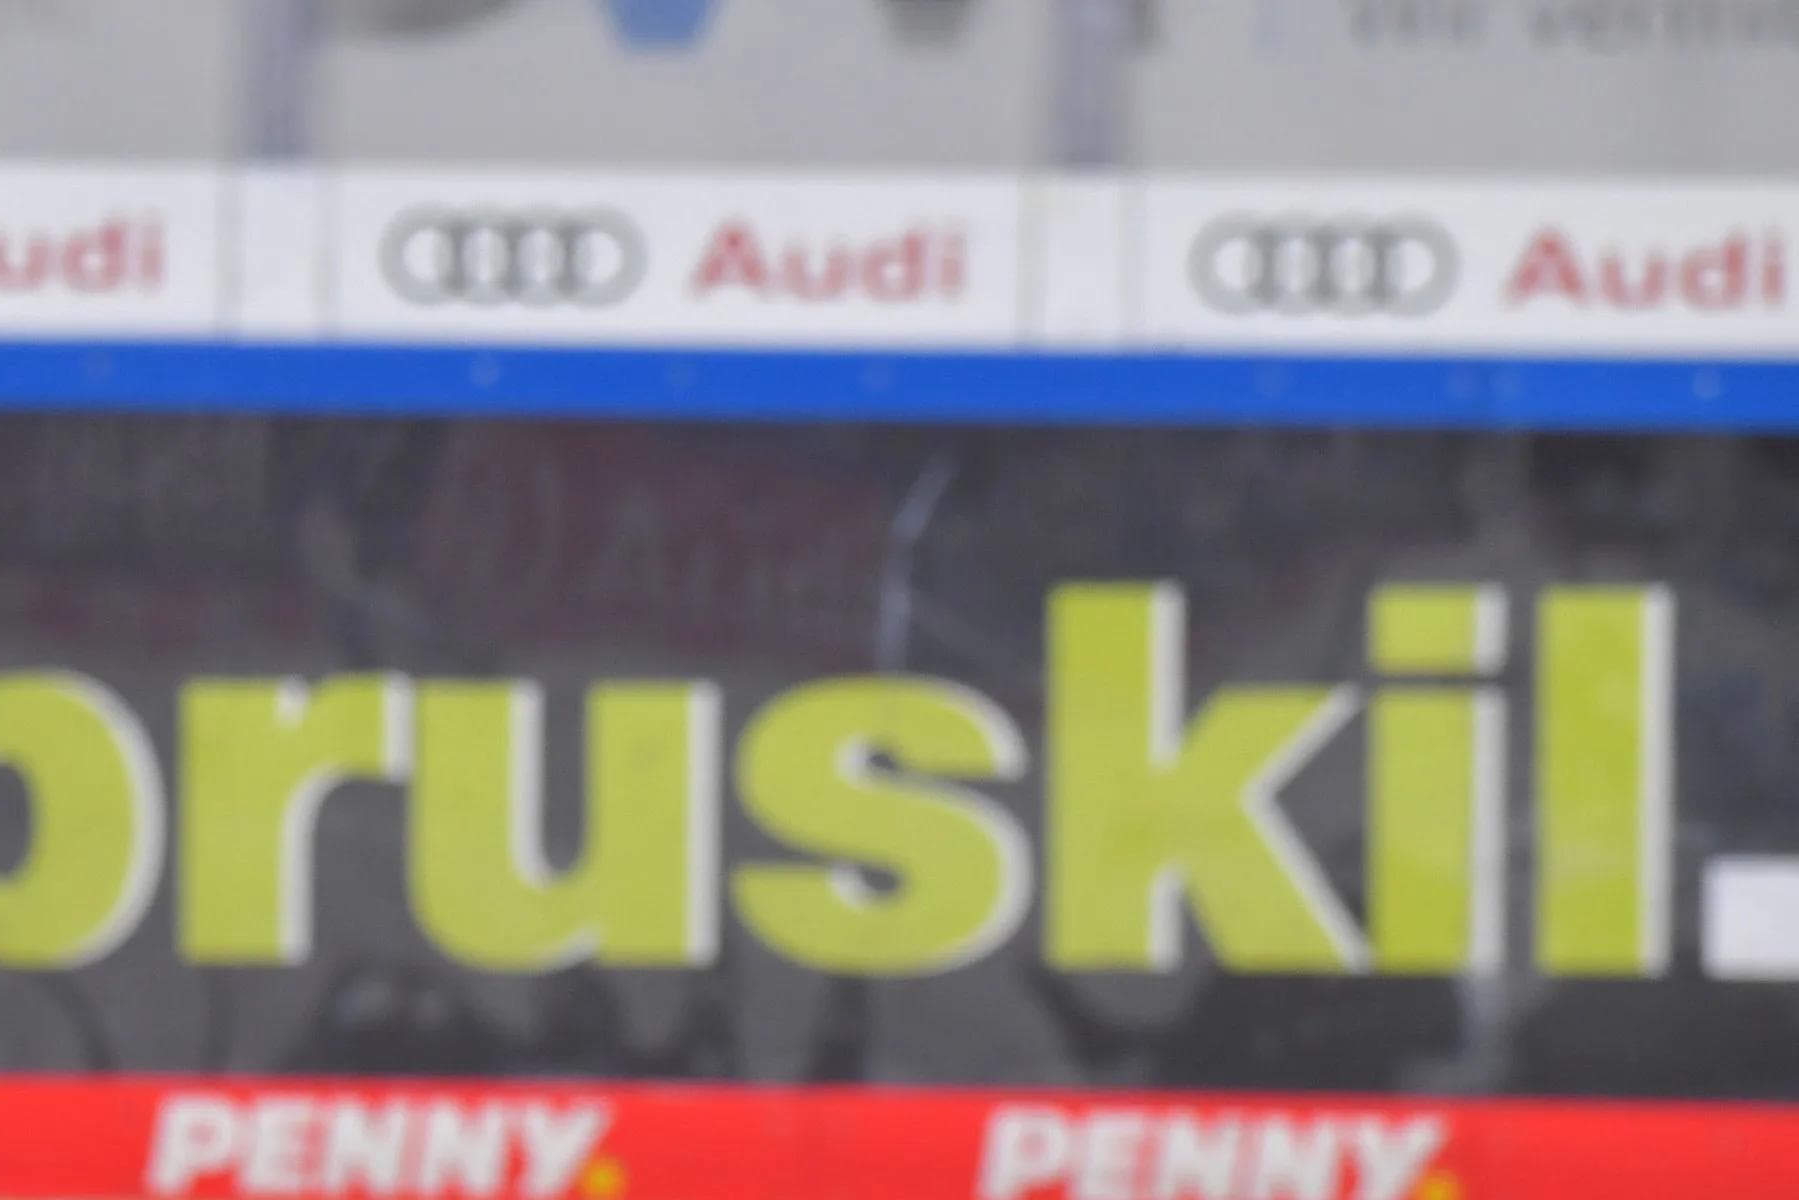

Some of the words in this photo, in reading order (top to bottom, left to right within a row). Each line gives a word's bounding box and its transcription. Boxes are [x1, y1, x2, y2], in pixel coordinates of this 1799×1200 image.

[690, 219, 969, 303] Audi
[1504, 227, 1787, 310] Audi
[145, 1093, 626, 1200] PENNY.
